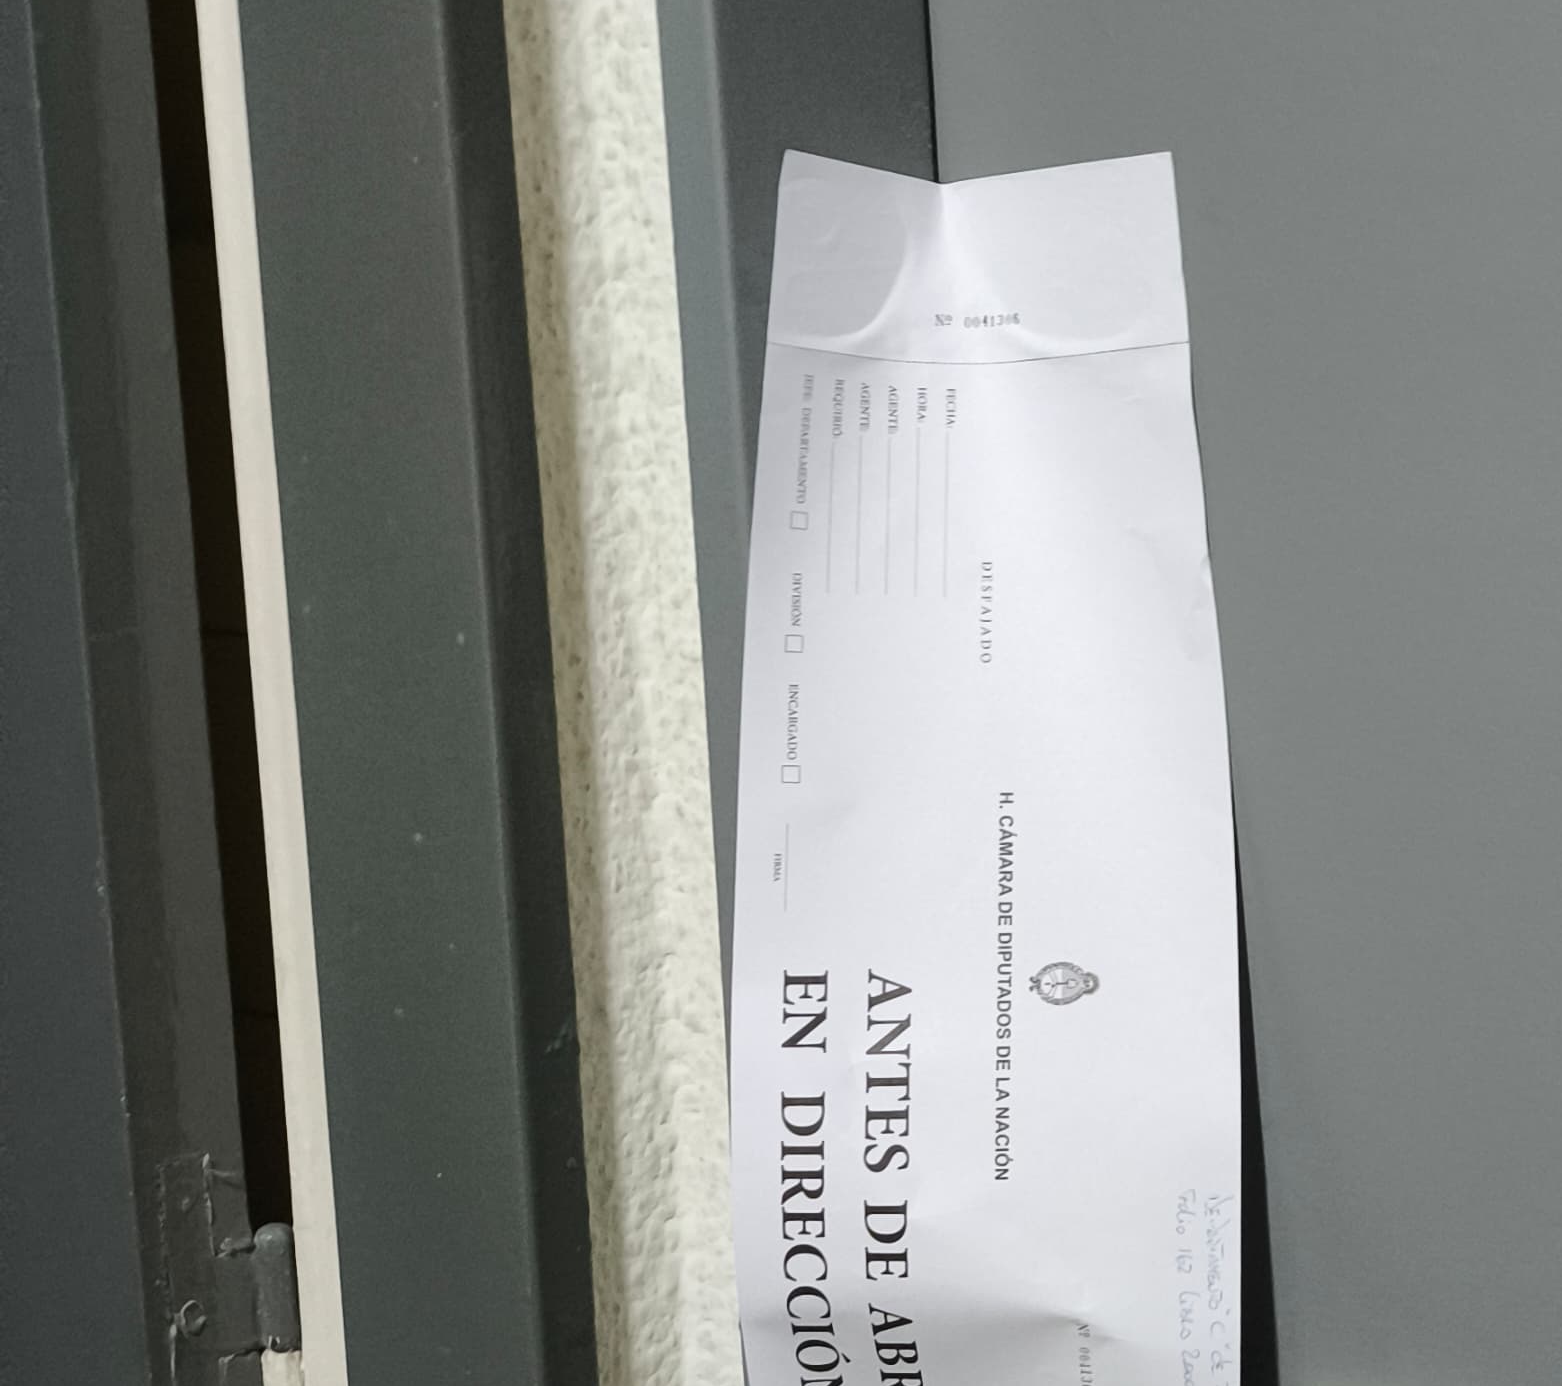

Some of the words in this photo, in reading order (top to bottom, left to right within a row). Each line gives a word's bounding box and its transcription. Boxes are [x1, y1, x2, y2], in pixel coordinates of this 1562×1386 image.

[794, 407, 813, 505] DEPARTAMENTO
[790, 572, 804, 627] DIVISIÓN
[785, 683, 800, 761] ENCARGADO
[997, 791, 1015, 810] H.
[996, 815, 1019, 896] CÁMARA
[996, 901, 1014, 926] DE
[781, 969, 829, 1054] EN
[995, 931, 1013, 1040] DIPUTADOS
[863, 968, 914, 1174] ANTES
[994, 1077, 1011, 1102] LA
[995, 1045, 1012, 1071] DE
[993, 1106, 1014, 1182] NACIÓN
[863, 1199, 910, 1281] DE
